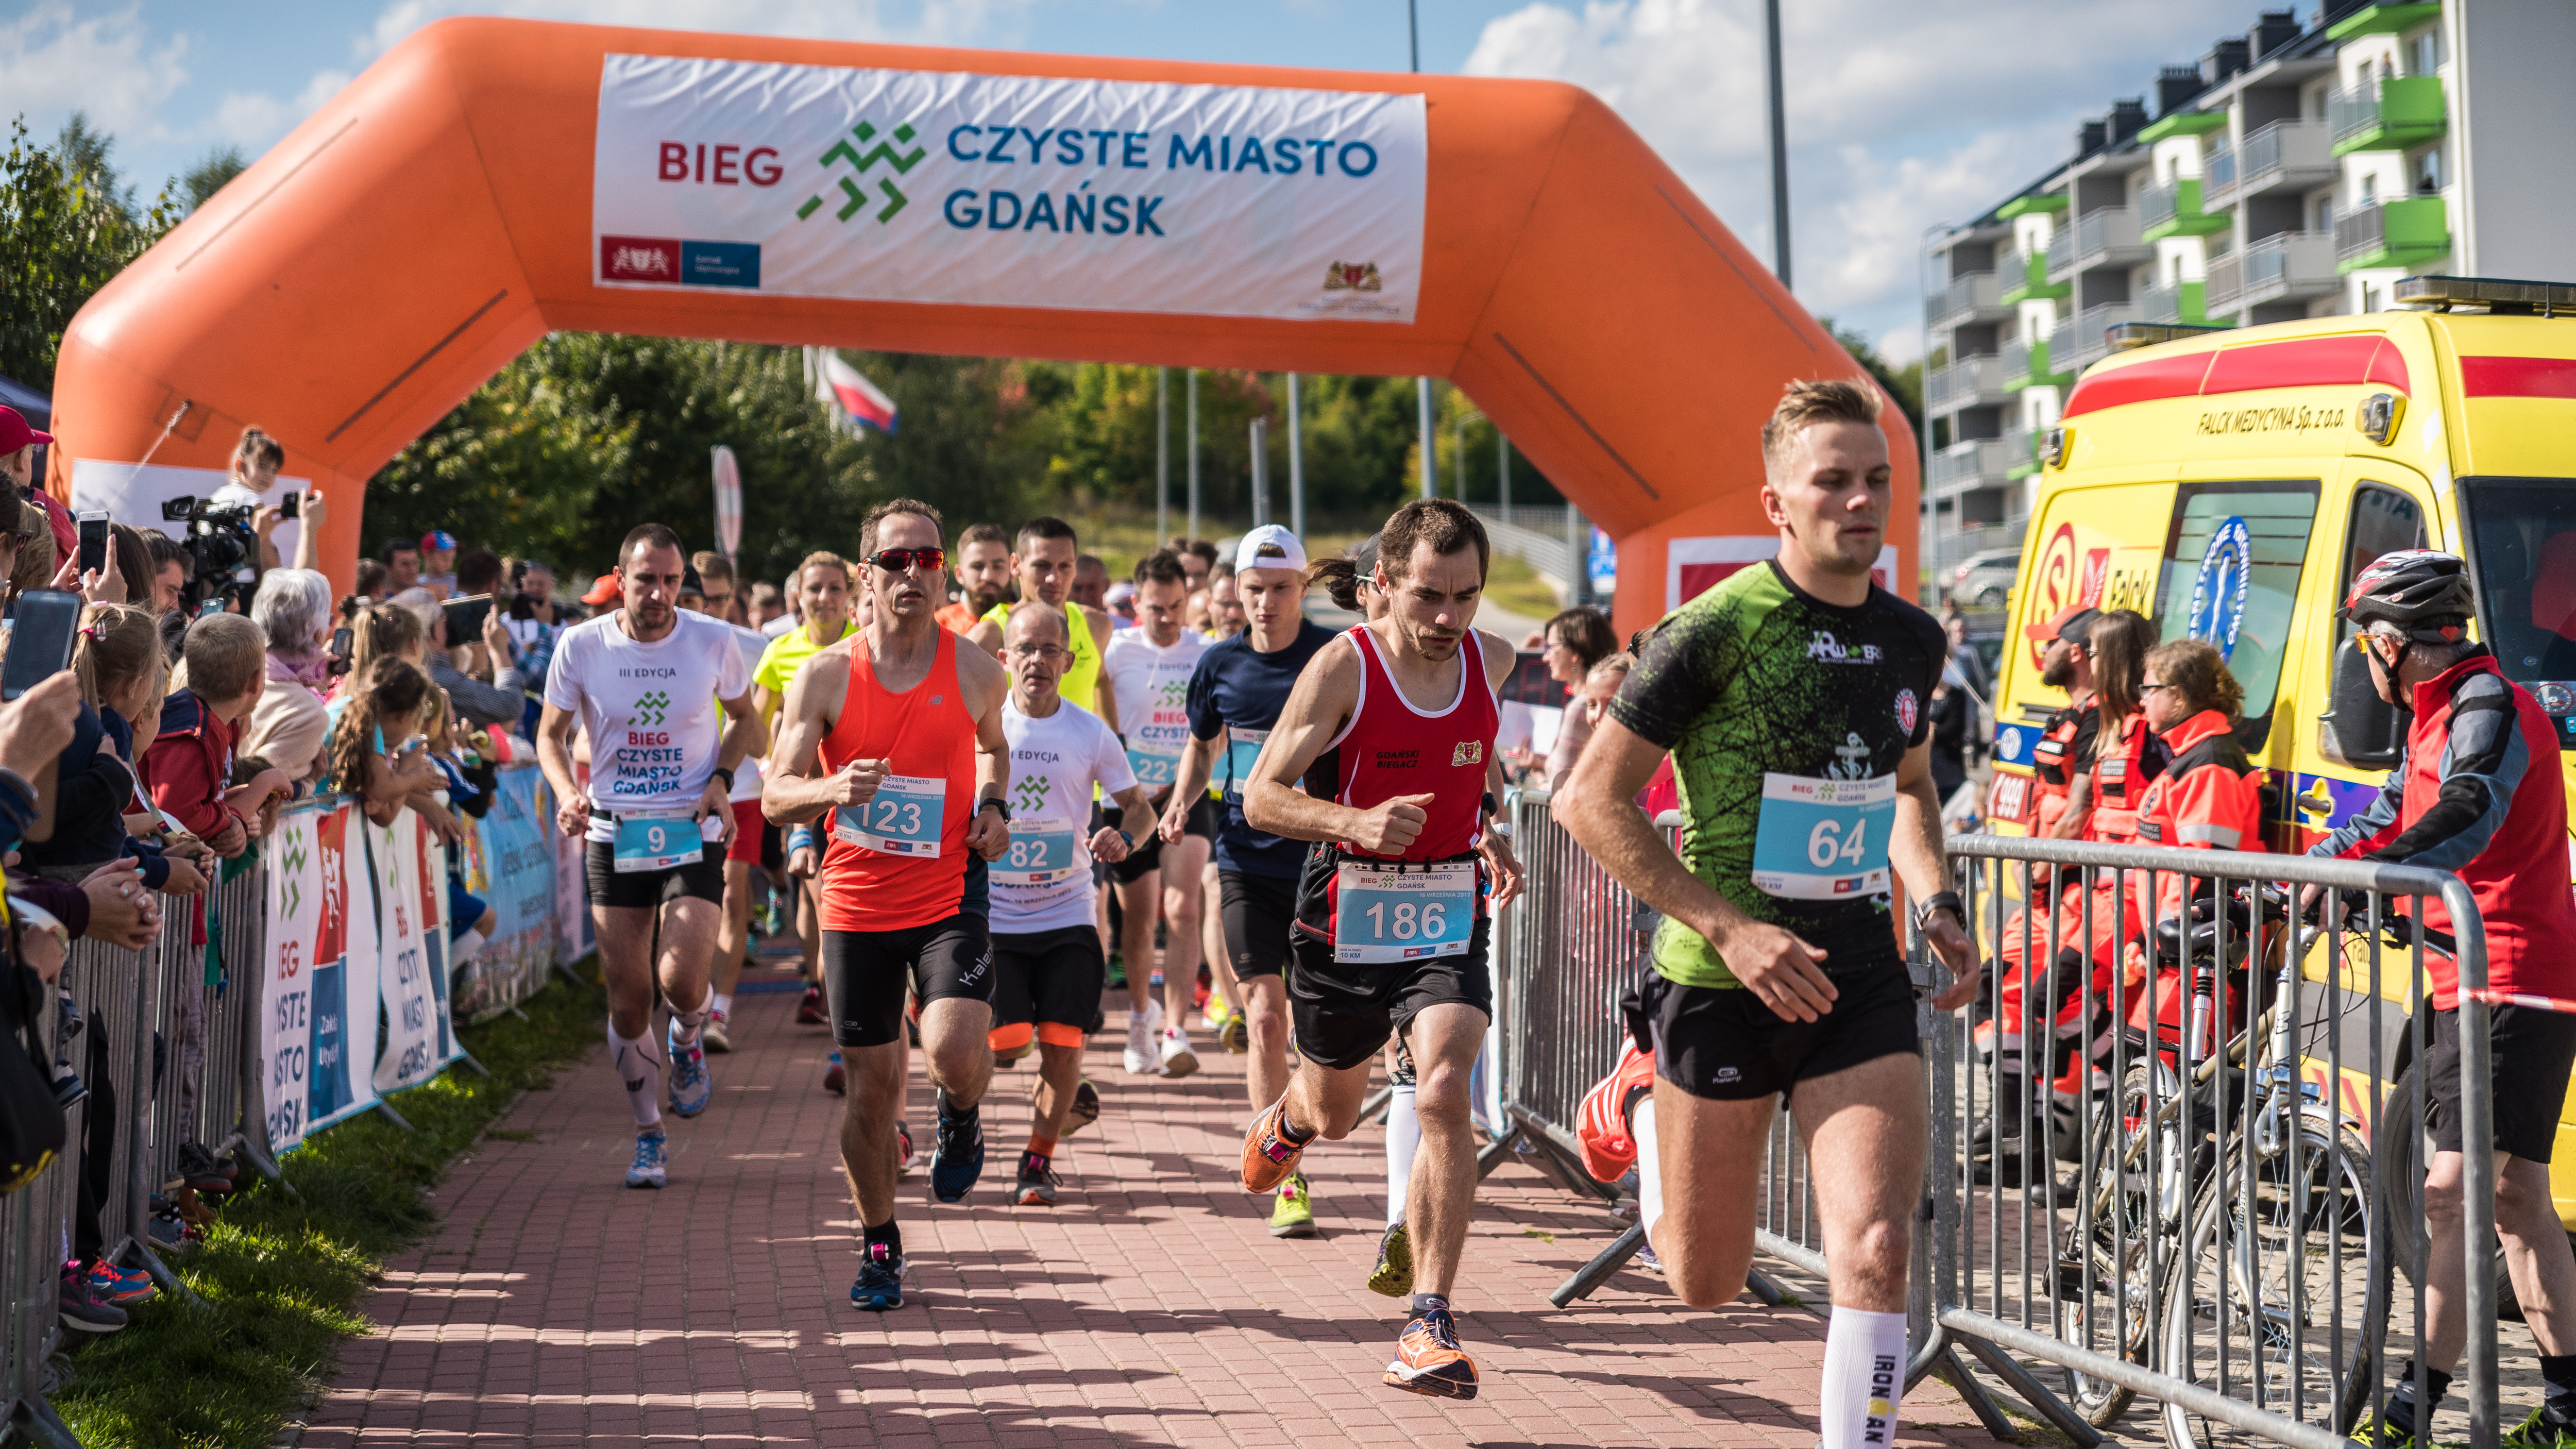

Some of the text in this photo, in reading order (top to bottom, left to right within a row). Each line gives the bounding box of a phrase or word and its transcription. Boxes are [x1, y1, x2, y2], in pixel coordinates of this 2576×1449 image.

[658, 141, 784, 187] BIEG
[947, 124, 1379, 178] CZYSTE MIASTO
[943, 180, 1166, 237] GDAŃSK
[2196, 411, 2233, 435] FALCK
[2231, 407, 2295, 433] MEDYCYNA
[2295, 405, 2311, 435] Sp.
[2314, 410, 2324, 428] z
[2109, 569, 2150, 613] Falck
[619, 668, 676, 679] III EDYCJA
[1154, 712, 1187, 724] BIEG
[628, 731, 669, 746] BIEG
[1376, 749, 1419, 759] GDAŃSKI
[617, 748, 683, 762] CZYSTE
[1018, 750, 1059, 764] EDYCJA
[1377, 760, 1418, 768] BIEGACZ
[618, 764, 683, 779] MIASTO
[1998, 776, 2026, 819] 999
[856, 800, 921, 835] 123
[648, 825, 666, 853] 9
[1010, 840, 1047, 868] 82
[1807, 818, 1866, 868] 64
[1366, 902, 1446, 940] 186
[278, 939, 299, 981] IEG
[959, 938, 992, 986] Kalen
[276, 990, 306, 1034] YSTE
